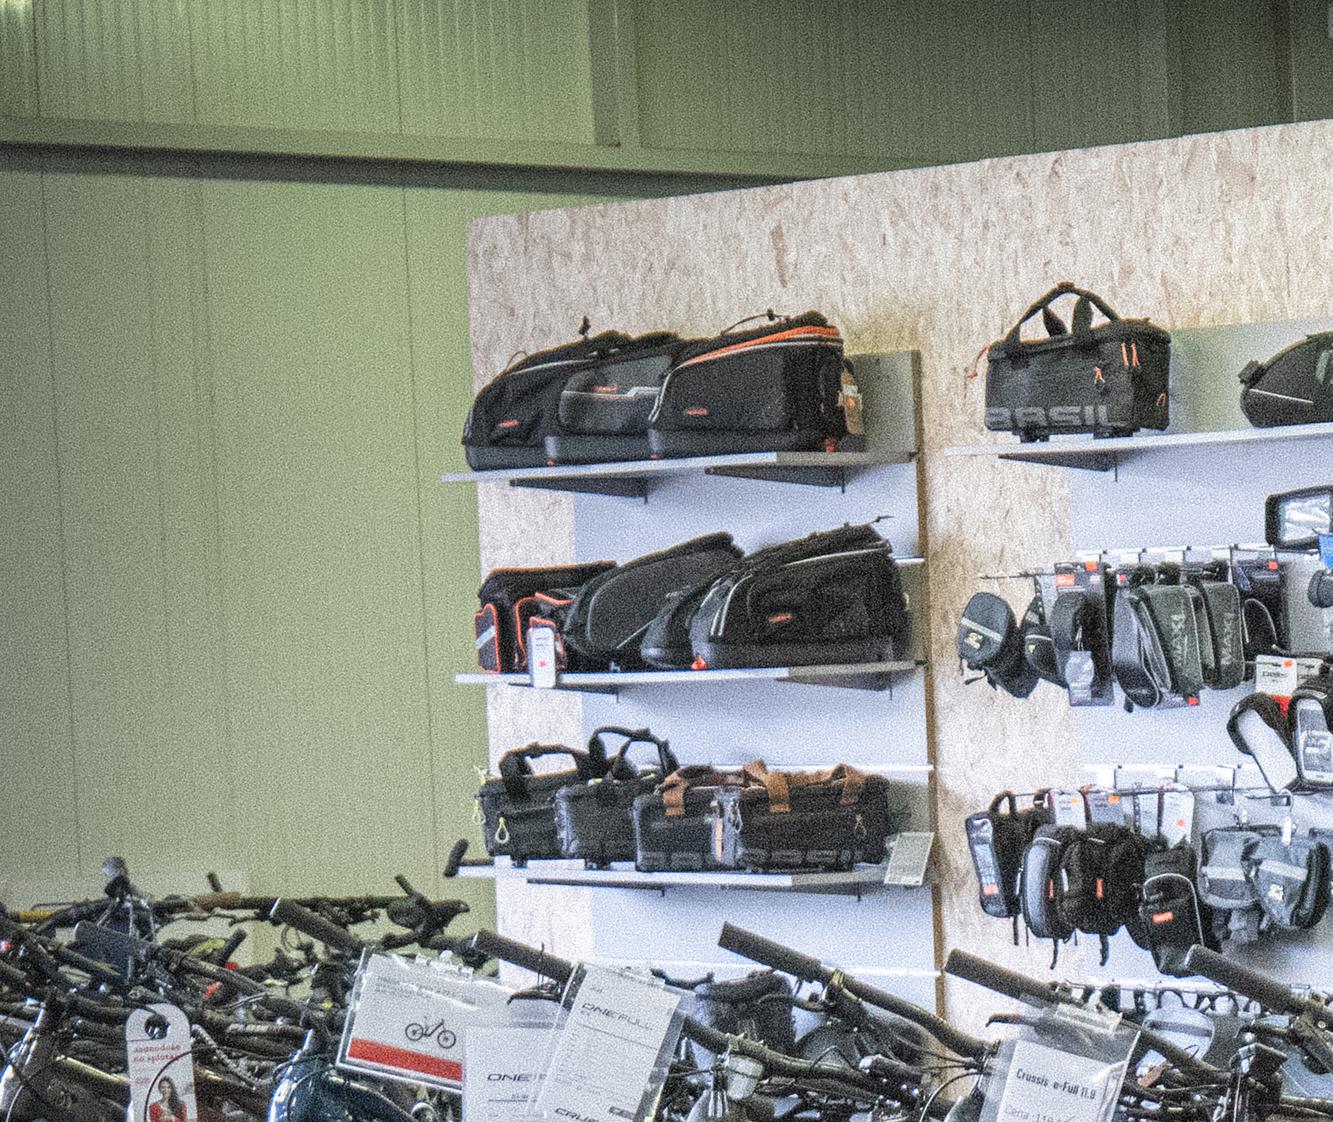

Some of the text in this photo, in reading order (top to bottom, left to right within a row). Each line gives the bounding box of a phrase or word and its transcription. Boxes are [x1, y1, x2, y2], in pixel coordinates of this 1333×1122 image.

[985, 404, 1127, 428] BASIL
[1016, 1068, 1049, 1088] Crussis
[1053, 1081, 1080, 1096] e-Full
[1005, 1104, 1030, 1121] Cena
